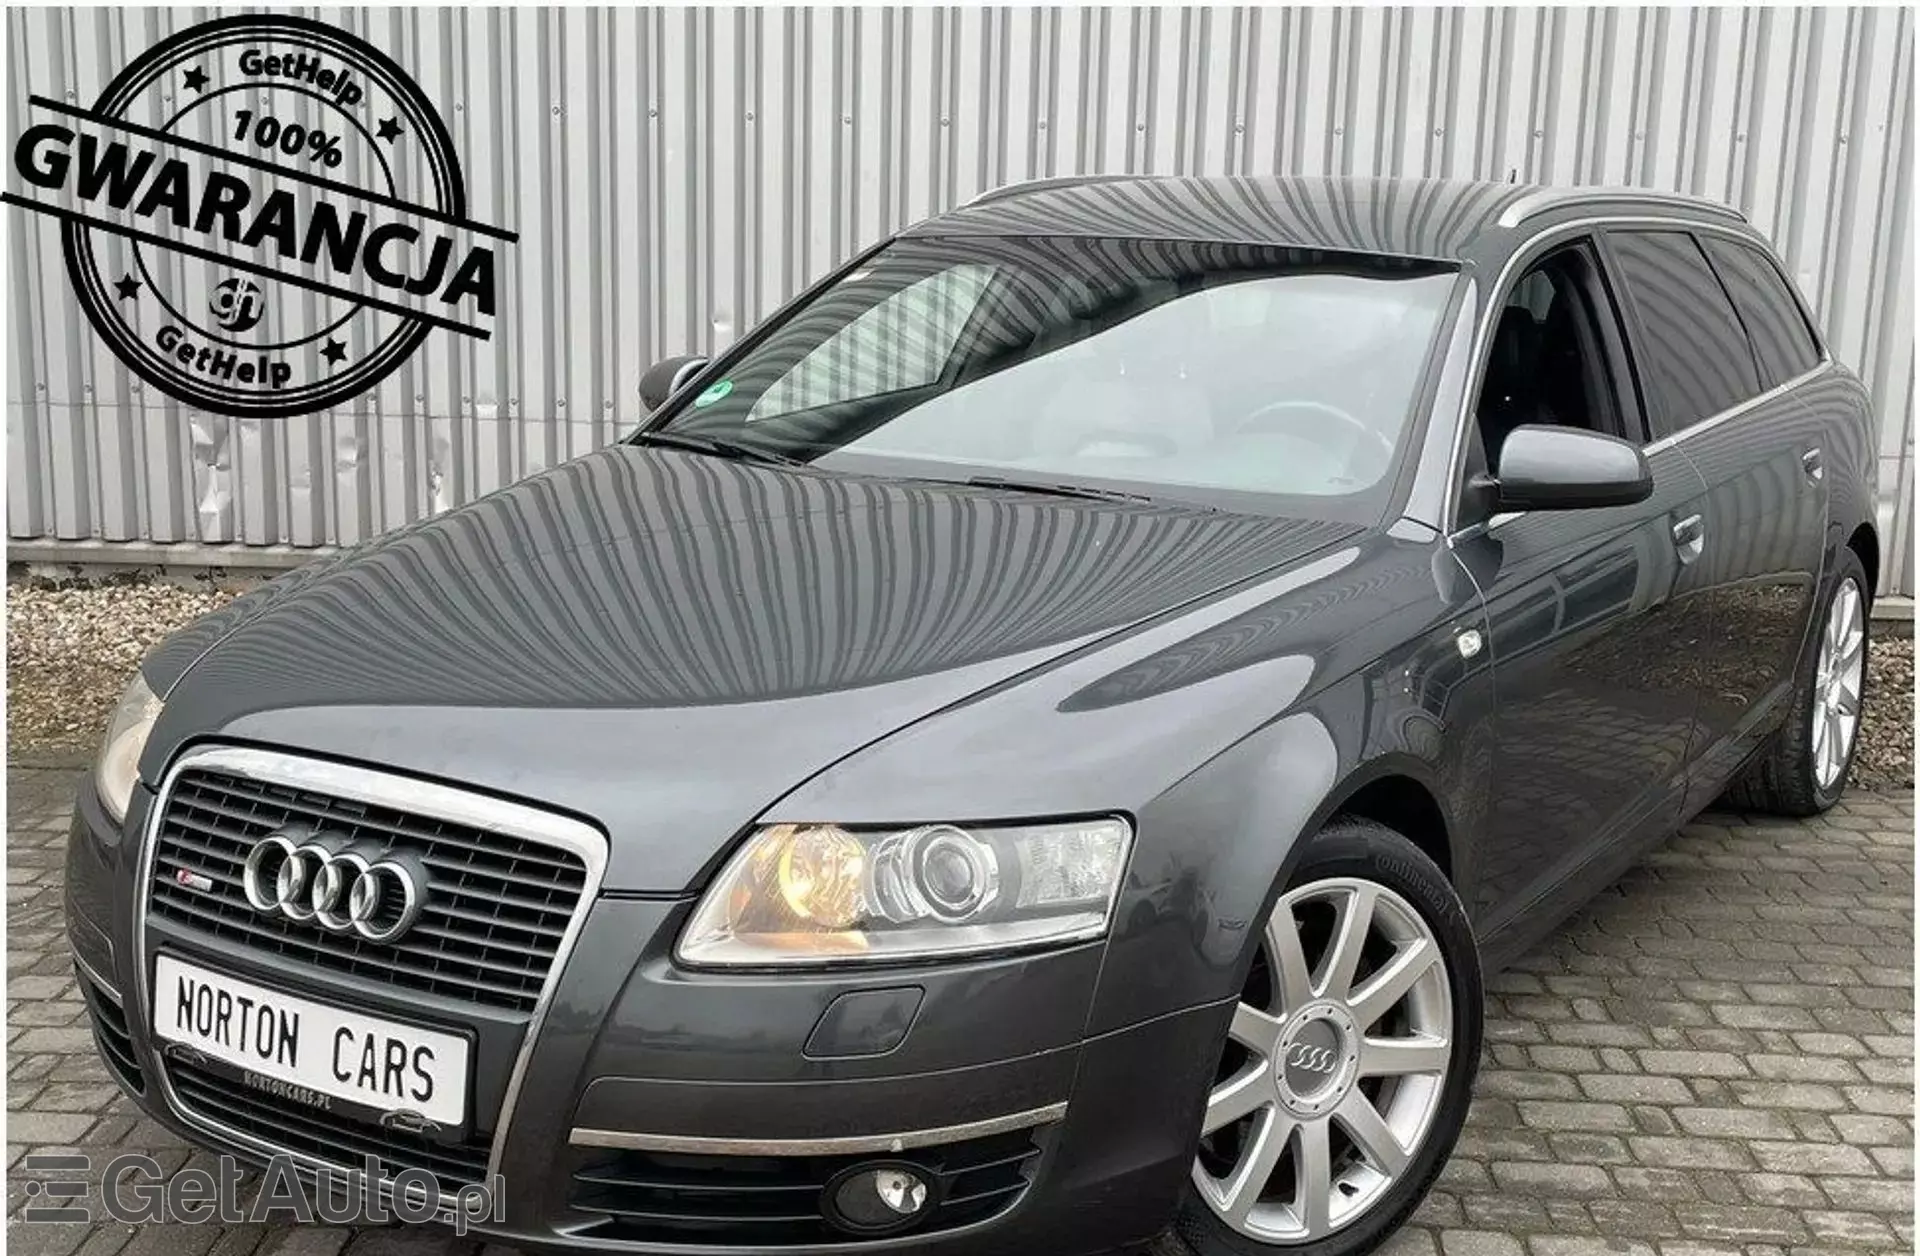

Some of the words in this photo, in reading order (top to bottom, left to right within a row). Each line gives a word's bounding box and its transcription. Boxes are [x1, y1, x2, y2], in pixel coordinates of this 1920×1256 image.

[176, 974, 299, 1068] NORTON
[332, 1025, 434, 1103] CARS
[244, 1070, 331, 1110] NORTONCARS.PL
